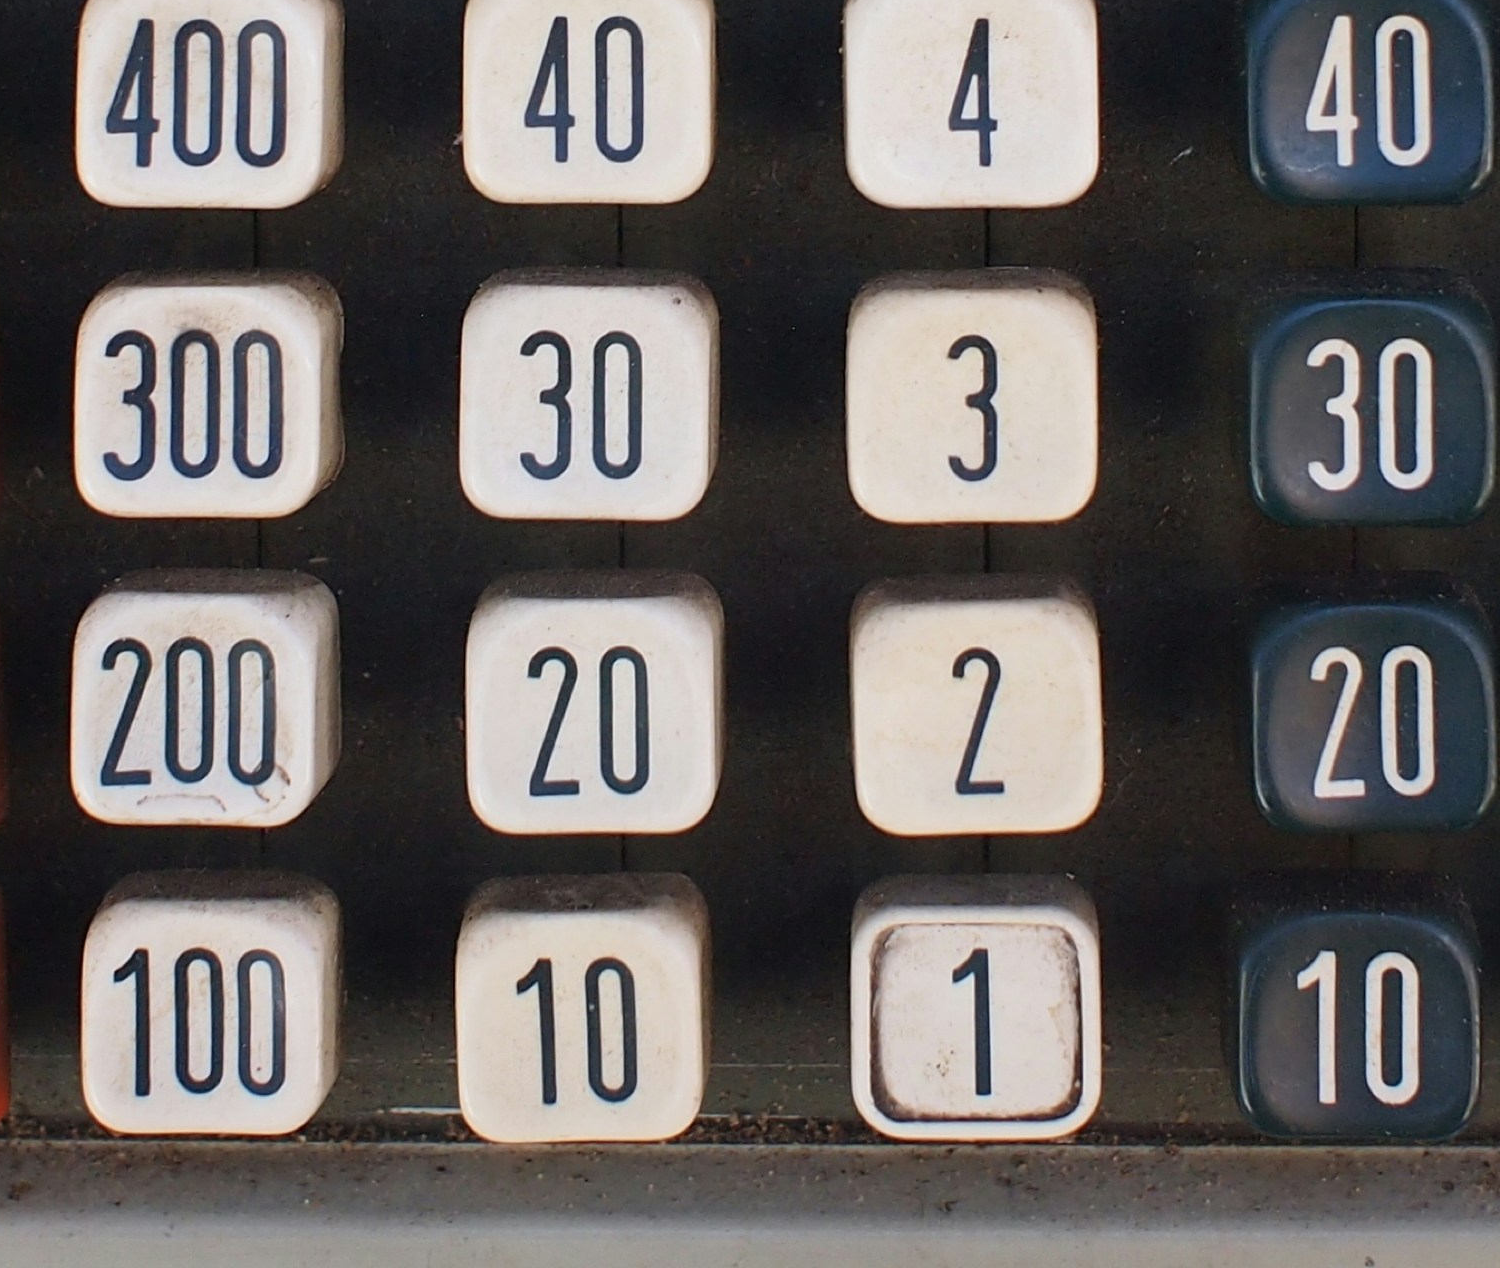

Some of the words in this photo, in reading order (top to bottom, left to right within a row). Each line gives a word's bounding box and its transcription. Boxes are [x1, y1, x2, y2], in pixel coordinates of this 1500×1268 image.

[105, 18, 287, 169] 400
[523, 15, 645, 164] 40
[948, 17, 998, 168] 4
[1304, 14, 1432, 169] 40
[102, 328, 284, 482] 300
[519, 329, 643, 481] 30
[947, 334, 999, 483] 3
[1305, 337, 1434, 493] 30
[99, 636, 277, 787] 200
[527, 645, 650, 798] 20
[951, 647, 1006, 796] 2
[1309, 644, 1436, 800] 20
[112, 946, 287, 1098] 100
[515, 956, 638, 1106] 10
[951, 948, 993, 1097] 1
[1296, 950, 1420, 1106] 10
